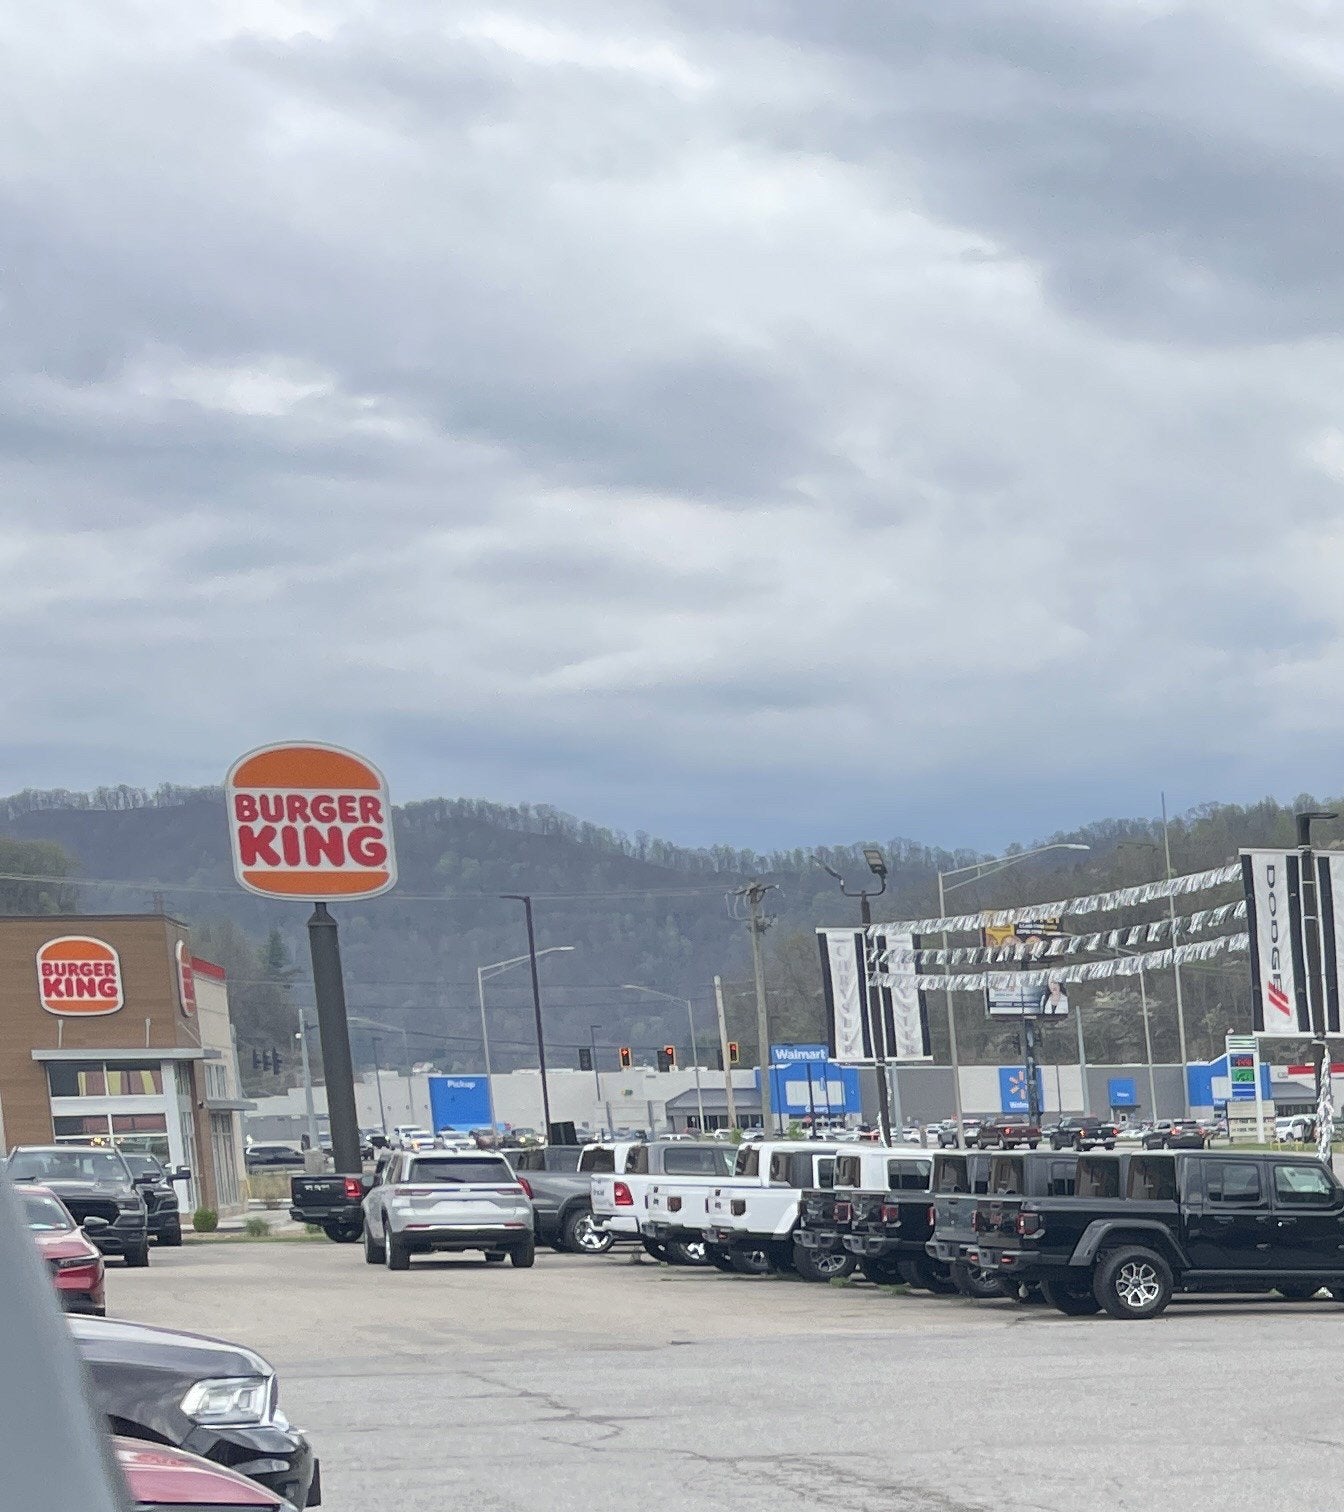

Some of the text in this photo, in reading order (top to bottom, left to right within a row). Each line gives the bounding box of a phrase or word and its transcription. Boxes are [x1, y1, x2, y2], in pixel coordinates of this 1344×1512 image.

[235, 794, 384, 824] BURGER
[238, 825, 388, 867] KING
[1267, 865, 1283, 993] DODGE
[41, 962, 116, 977] BURGER
[42, 978, 118, 998] KING
[776, 1048, 826, 1060] Walmart
